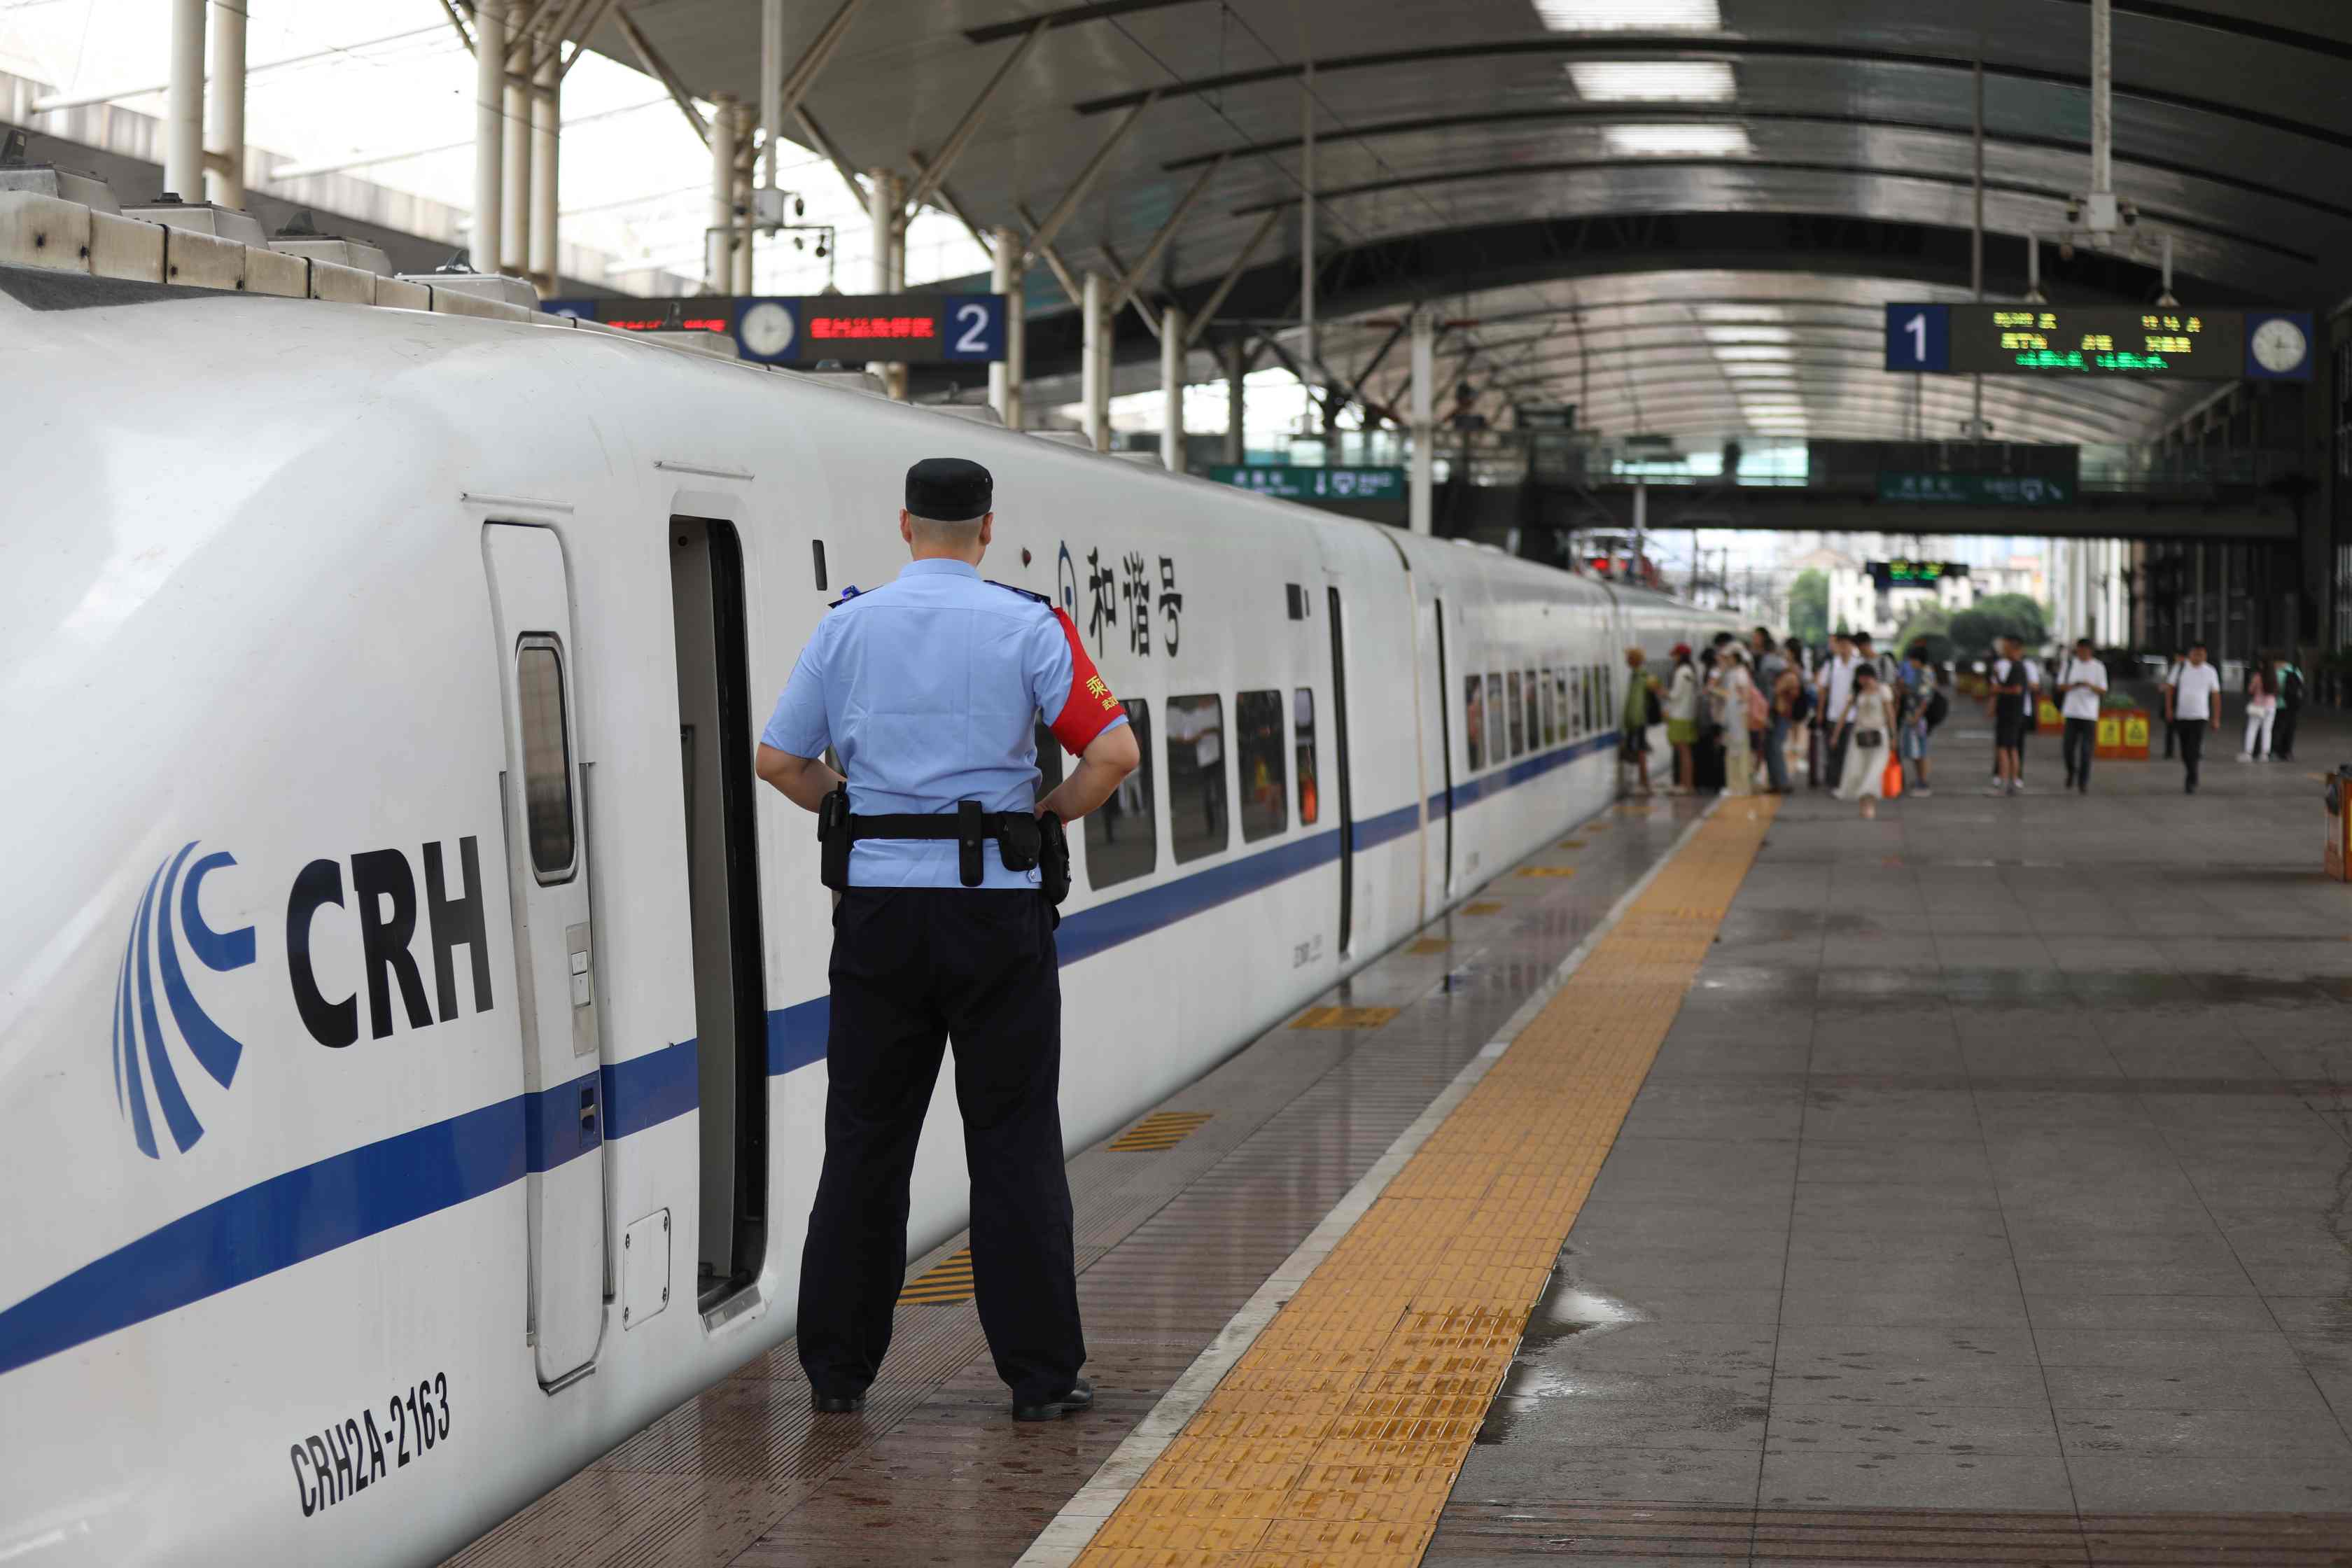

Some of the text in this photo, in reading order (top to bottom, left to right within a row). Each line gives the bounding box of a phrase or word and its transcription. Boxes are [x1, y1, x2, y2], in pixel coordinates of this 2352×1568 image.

[955, 304, 989, 353] 2
[1904, 313, 1926, 362] 1
[1087, 546, 1182, 659] 和谐号
[286, 835, 494, 1049] CRH
[290, 1371, 450, 1518] CRH2A-2163
